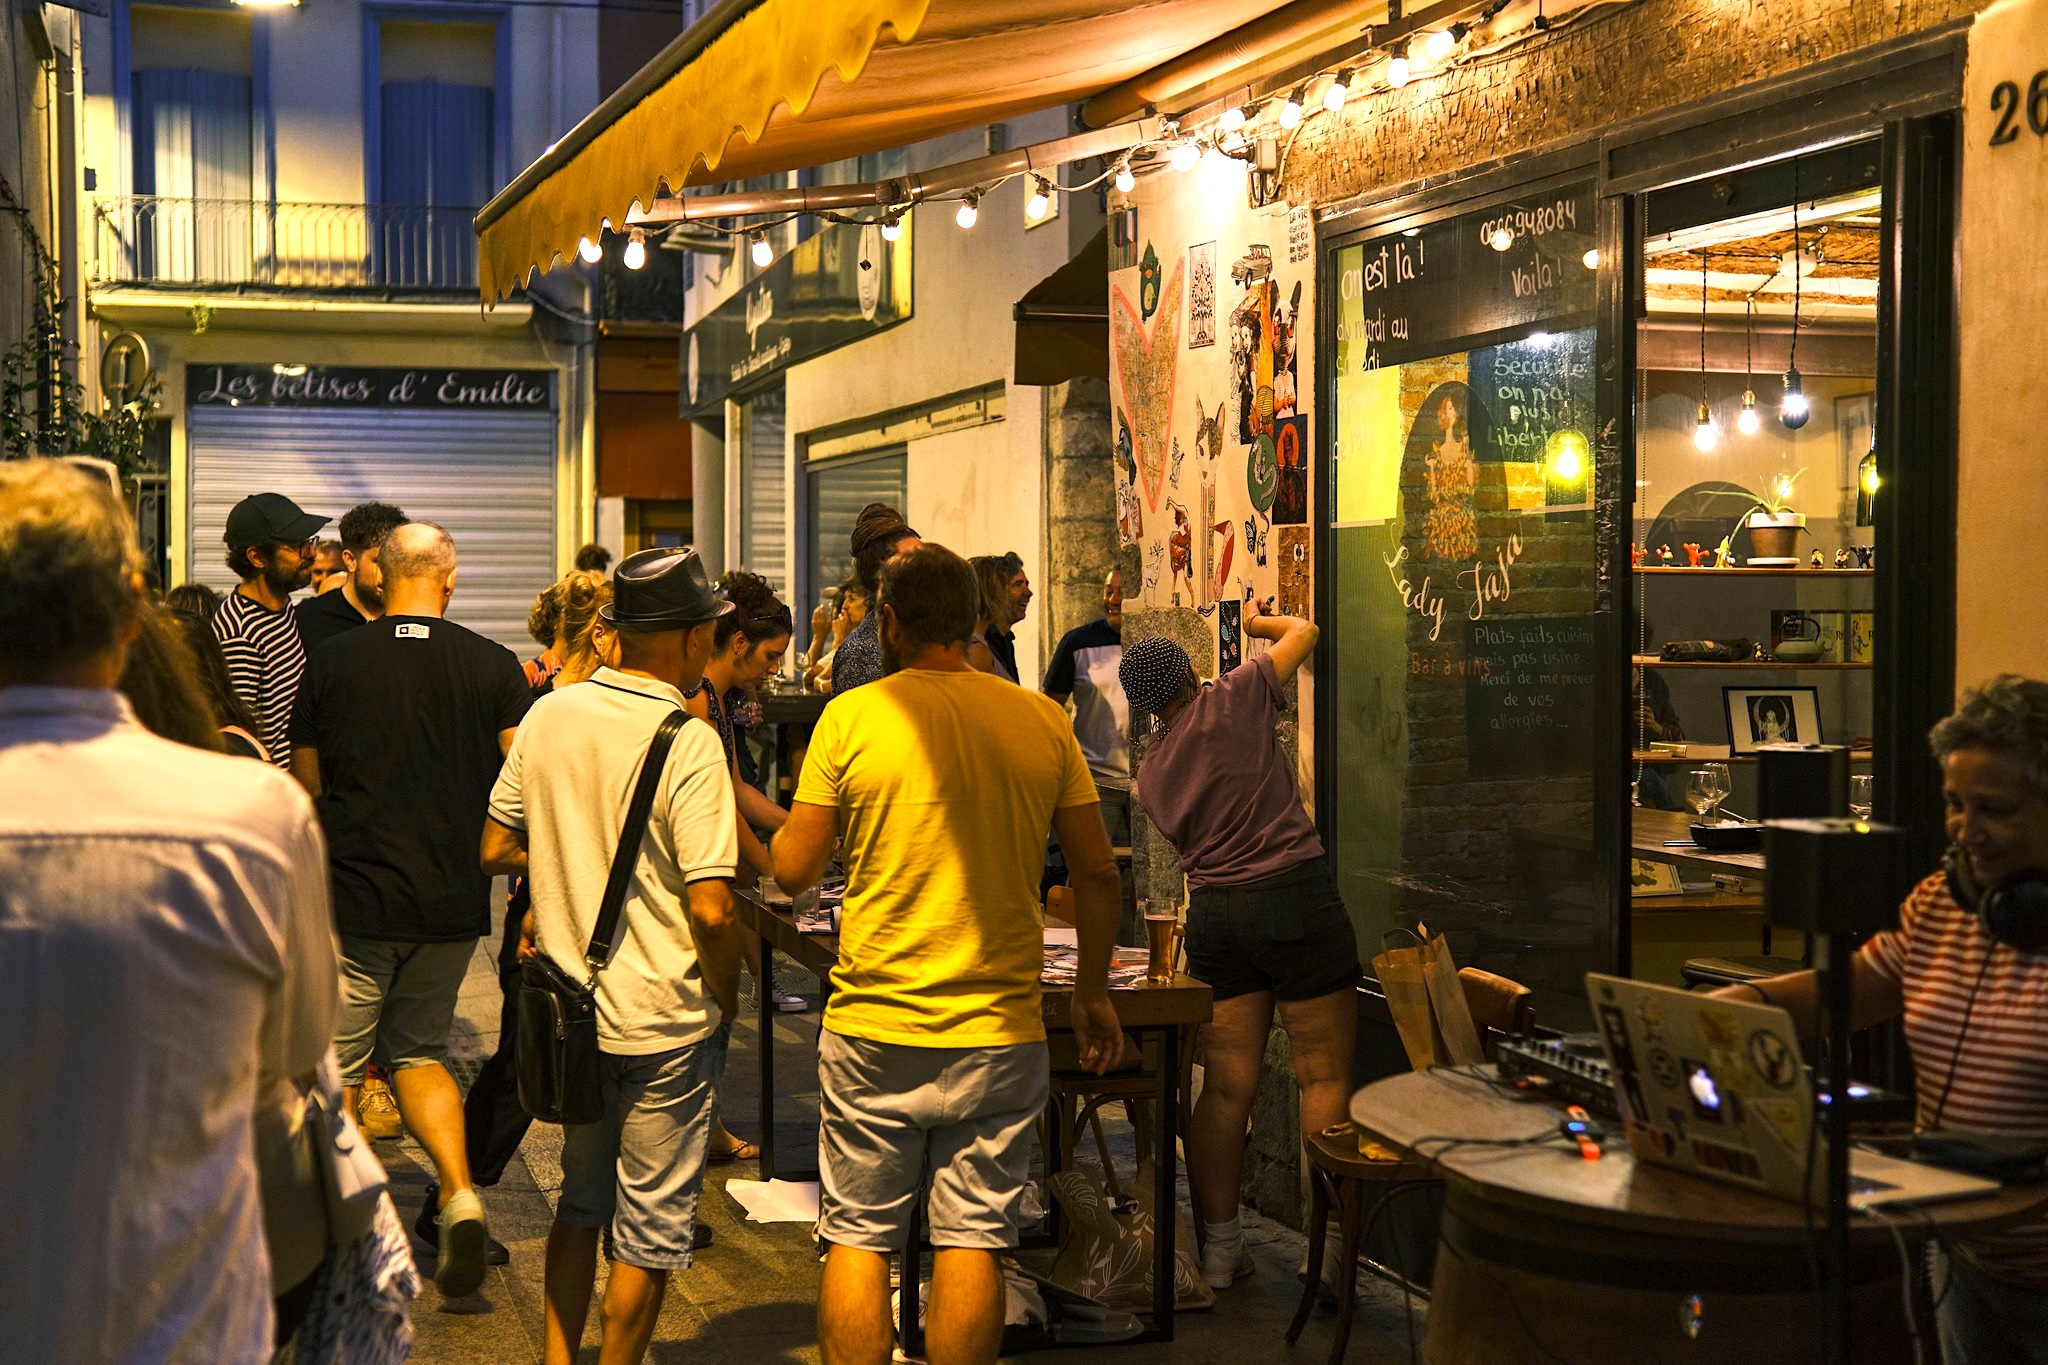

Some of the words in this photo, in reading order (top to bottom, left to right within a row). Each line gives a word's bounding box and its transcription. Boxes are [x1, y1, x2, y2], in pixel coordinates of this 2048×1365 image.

[1988, 69, 2048, 147] 26
[1364, 244, 1389, 292] est
[1354, 307, 1386, 343] mardi
[1391, 317, 1409, 341] au
[197, 366, 262, 404] Les
[1498, 386, 1526, 402] on
[1382, 522, 1448, 642] Lady
[1455, 520, 1524, 621] Jaja
[1475, 625, 1514, 645] Plats
[1520, 625, 1554, 650] faits
[1412, 652, 1437, 675] Bar
[1443, 650, 1451, 676] à
[1458, 653, 1491, 677] vins
[1475, 651, 1506, 667] mais
[1512, 652, 1537, 669] pas
[1480, 670, 1511, 687] Merci
[1518, 670, 1532, 685] de
[1503, 691, 1519, 707] de
[1528, 694, 1554, 707] vos
